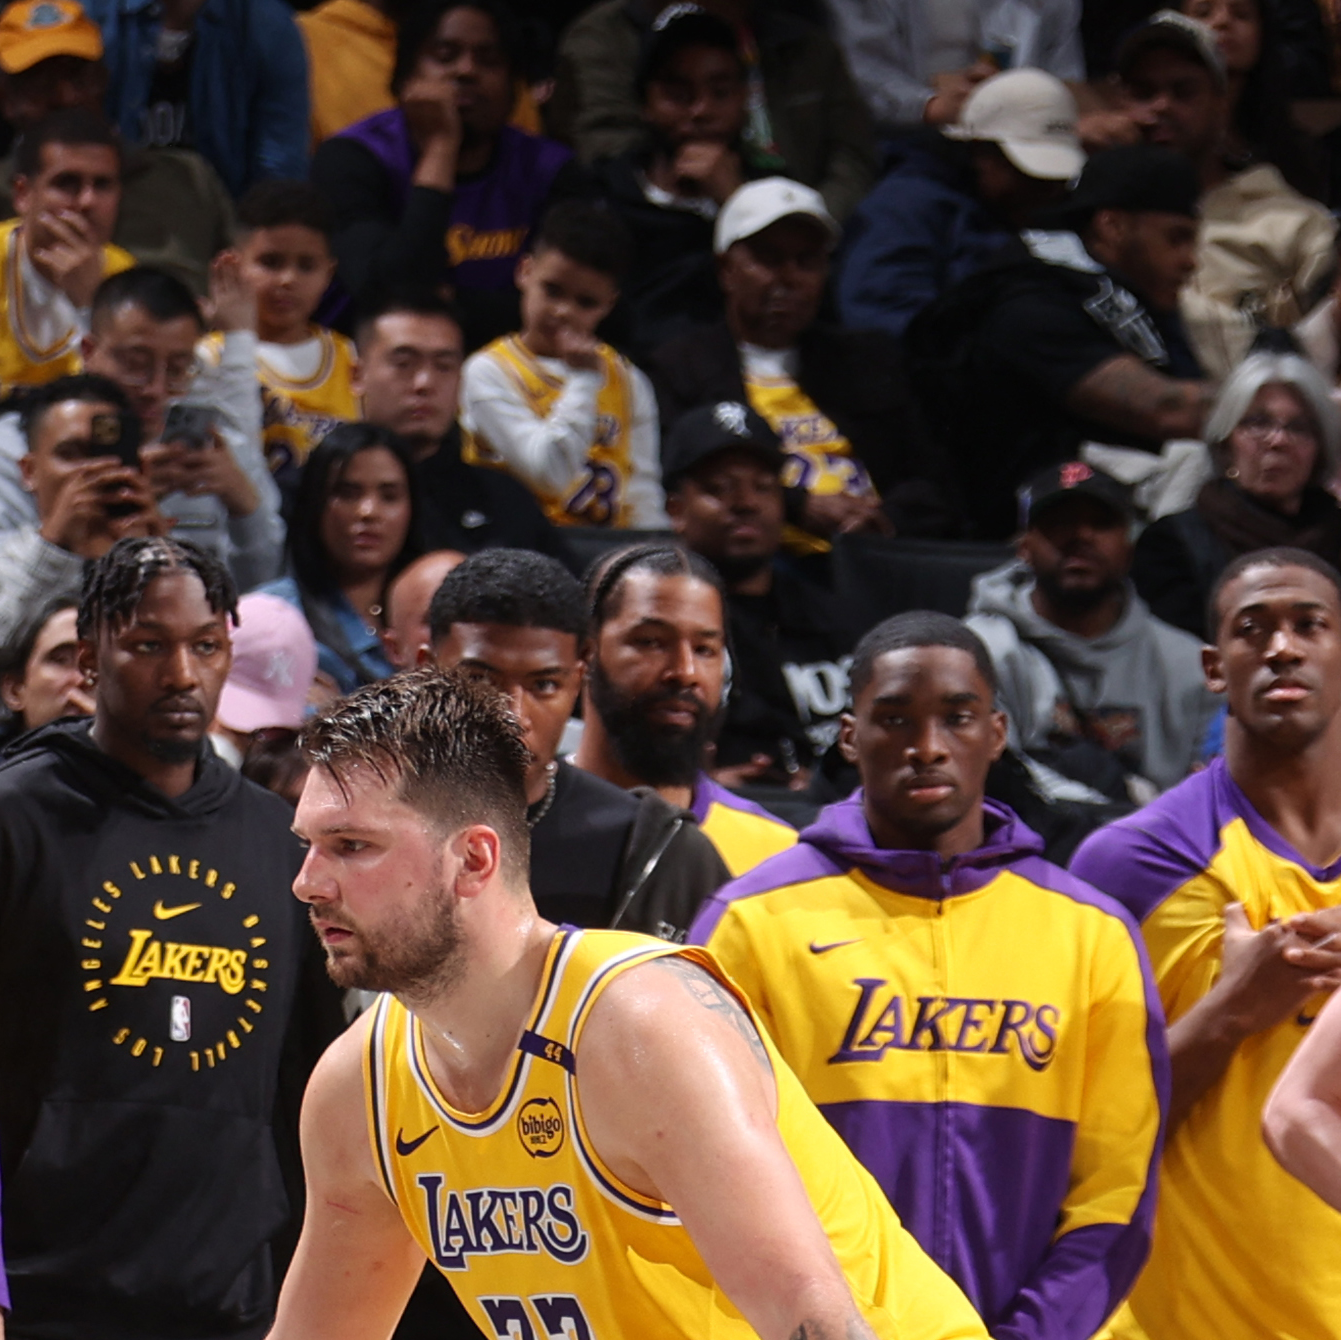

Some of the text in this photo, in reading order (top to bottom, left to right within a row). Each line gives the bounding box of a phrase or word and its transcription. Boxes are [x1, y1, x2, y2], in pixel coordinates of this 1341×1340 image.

[109, 928, 249, 996] LAKERS
[544, 1042, 563, 1062] 44
[827, 977, 1061, 1074] LAKERS
[521, 1113, 561, 1140] bibigo
[415, 1172, 589, 1272] LAKERS
